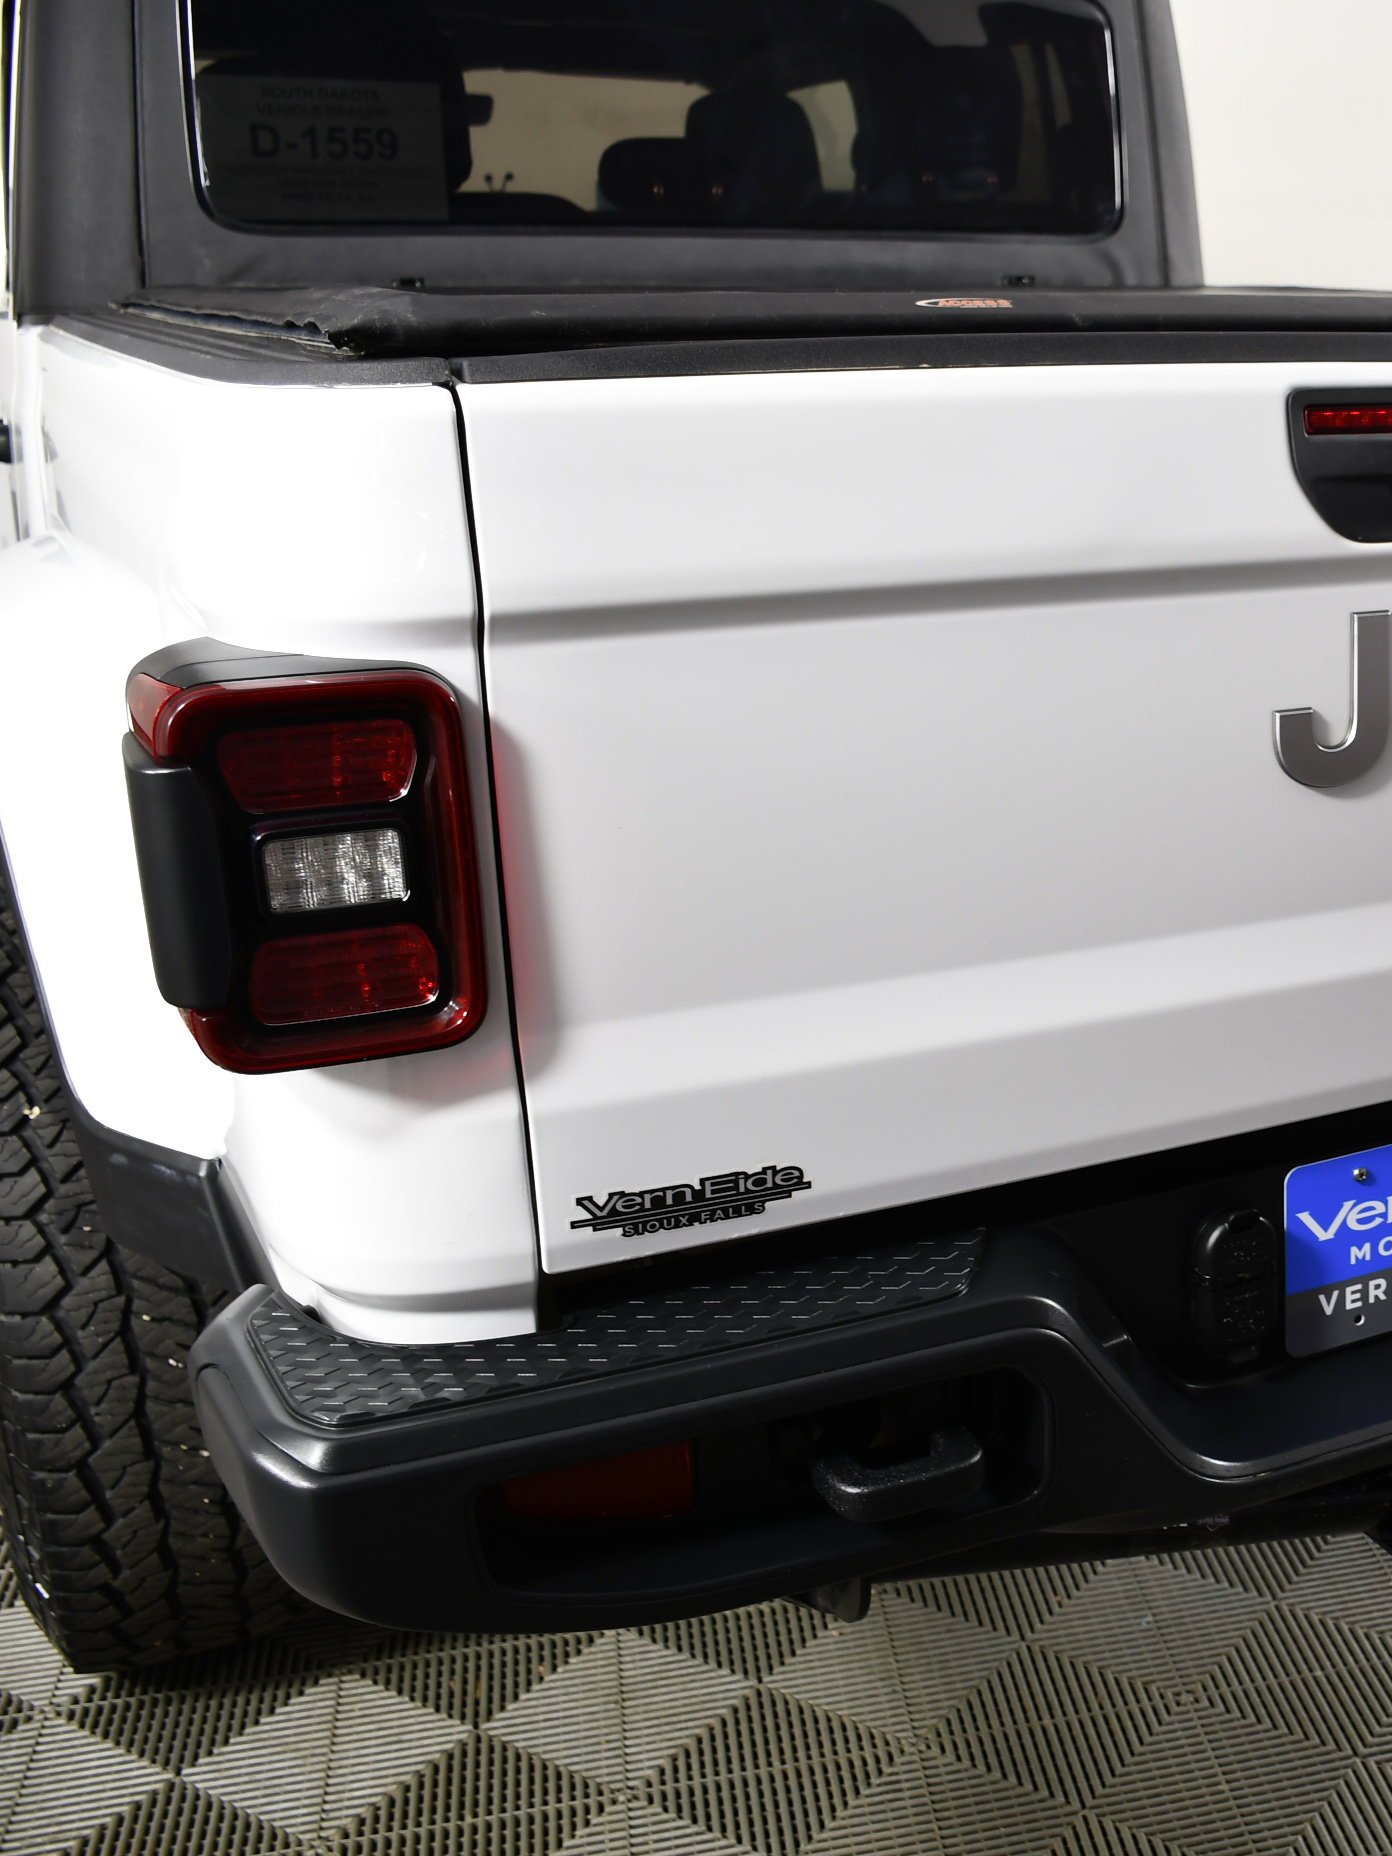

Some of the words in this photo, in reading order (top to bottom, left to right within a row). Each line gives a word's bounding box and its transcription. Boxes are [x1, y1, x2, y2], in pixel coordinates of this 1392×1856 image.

[249, 123, 399, 161] D-1559
[579, 1185, 695, 1218] Vern
[703, 1168, 801, 1199] Eide
[623, 1214, 690, 1237] SIOUX
[700, 1202, 766, 1223] FALLS
